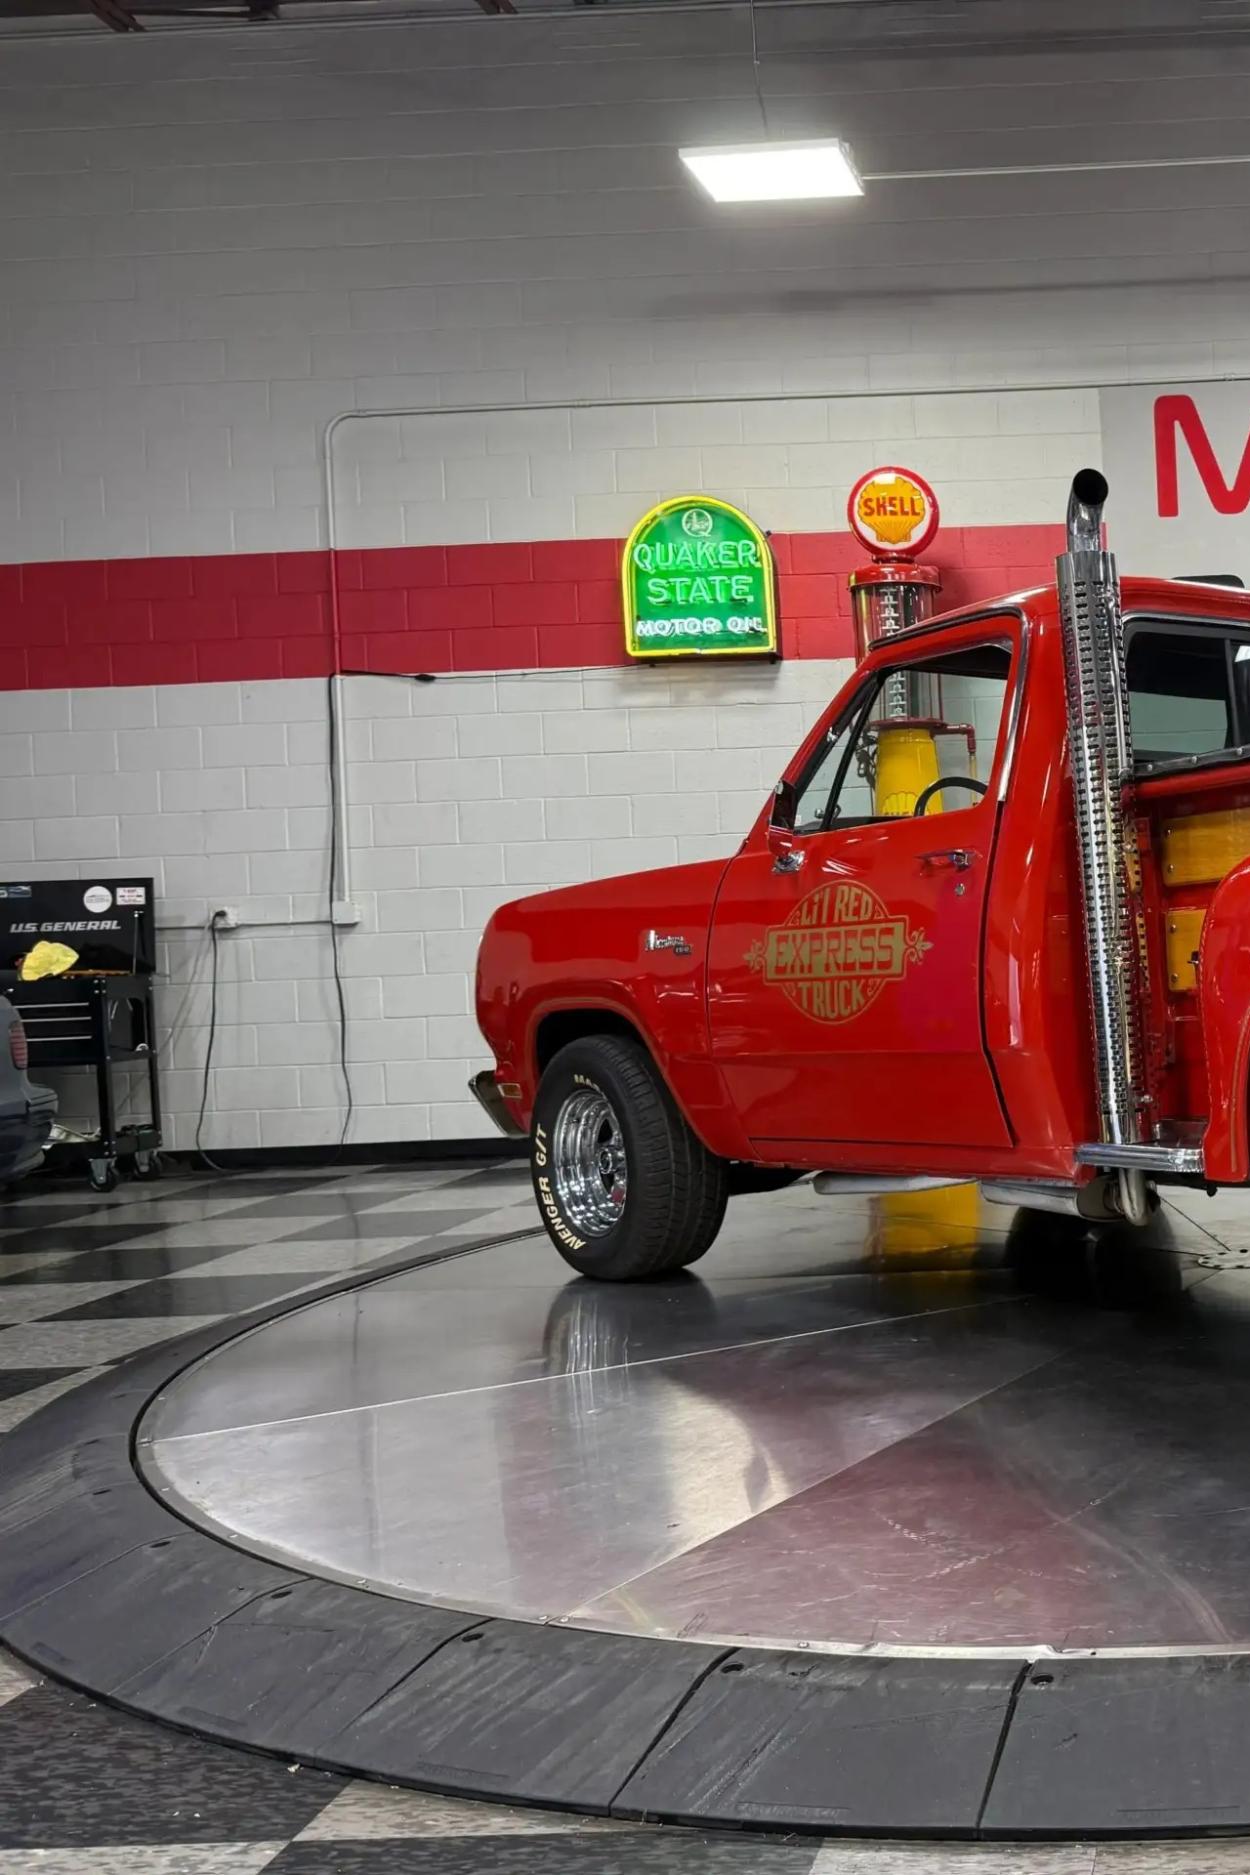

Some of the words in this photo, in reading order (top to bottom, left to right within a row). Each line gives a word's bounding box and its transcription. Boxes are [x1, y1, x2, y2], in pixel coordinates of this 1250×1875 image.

[863, 495, 922, 518] SHELL
[633, 540, 762, 574] QUAKER
[647, 575, 754, 605] STATE
[636, 617, 723, 637] MOTOR
[726, 616, 767, 635] OIL
[833, 885, 873, 923] RED
[39, 919, 122, 933] GENERAL
[774, 927, 895, 976] EXPRESS
[798, 978, 866, 1019] TRUCK
[535, 1123, 548, 1166] G/T
[538, 1177, 587, 1251] AVENGER
